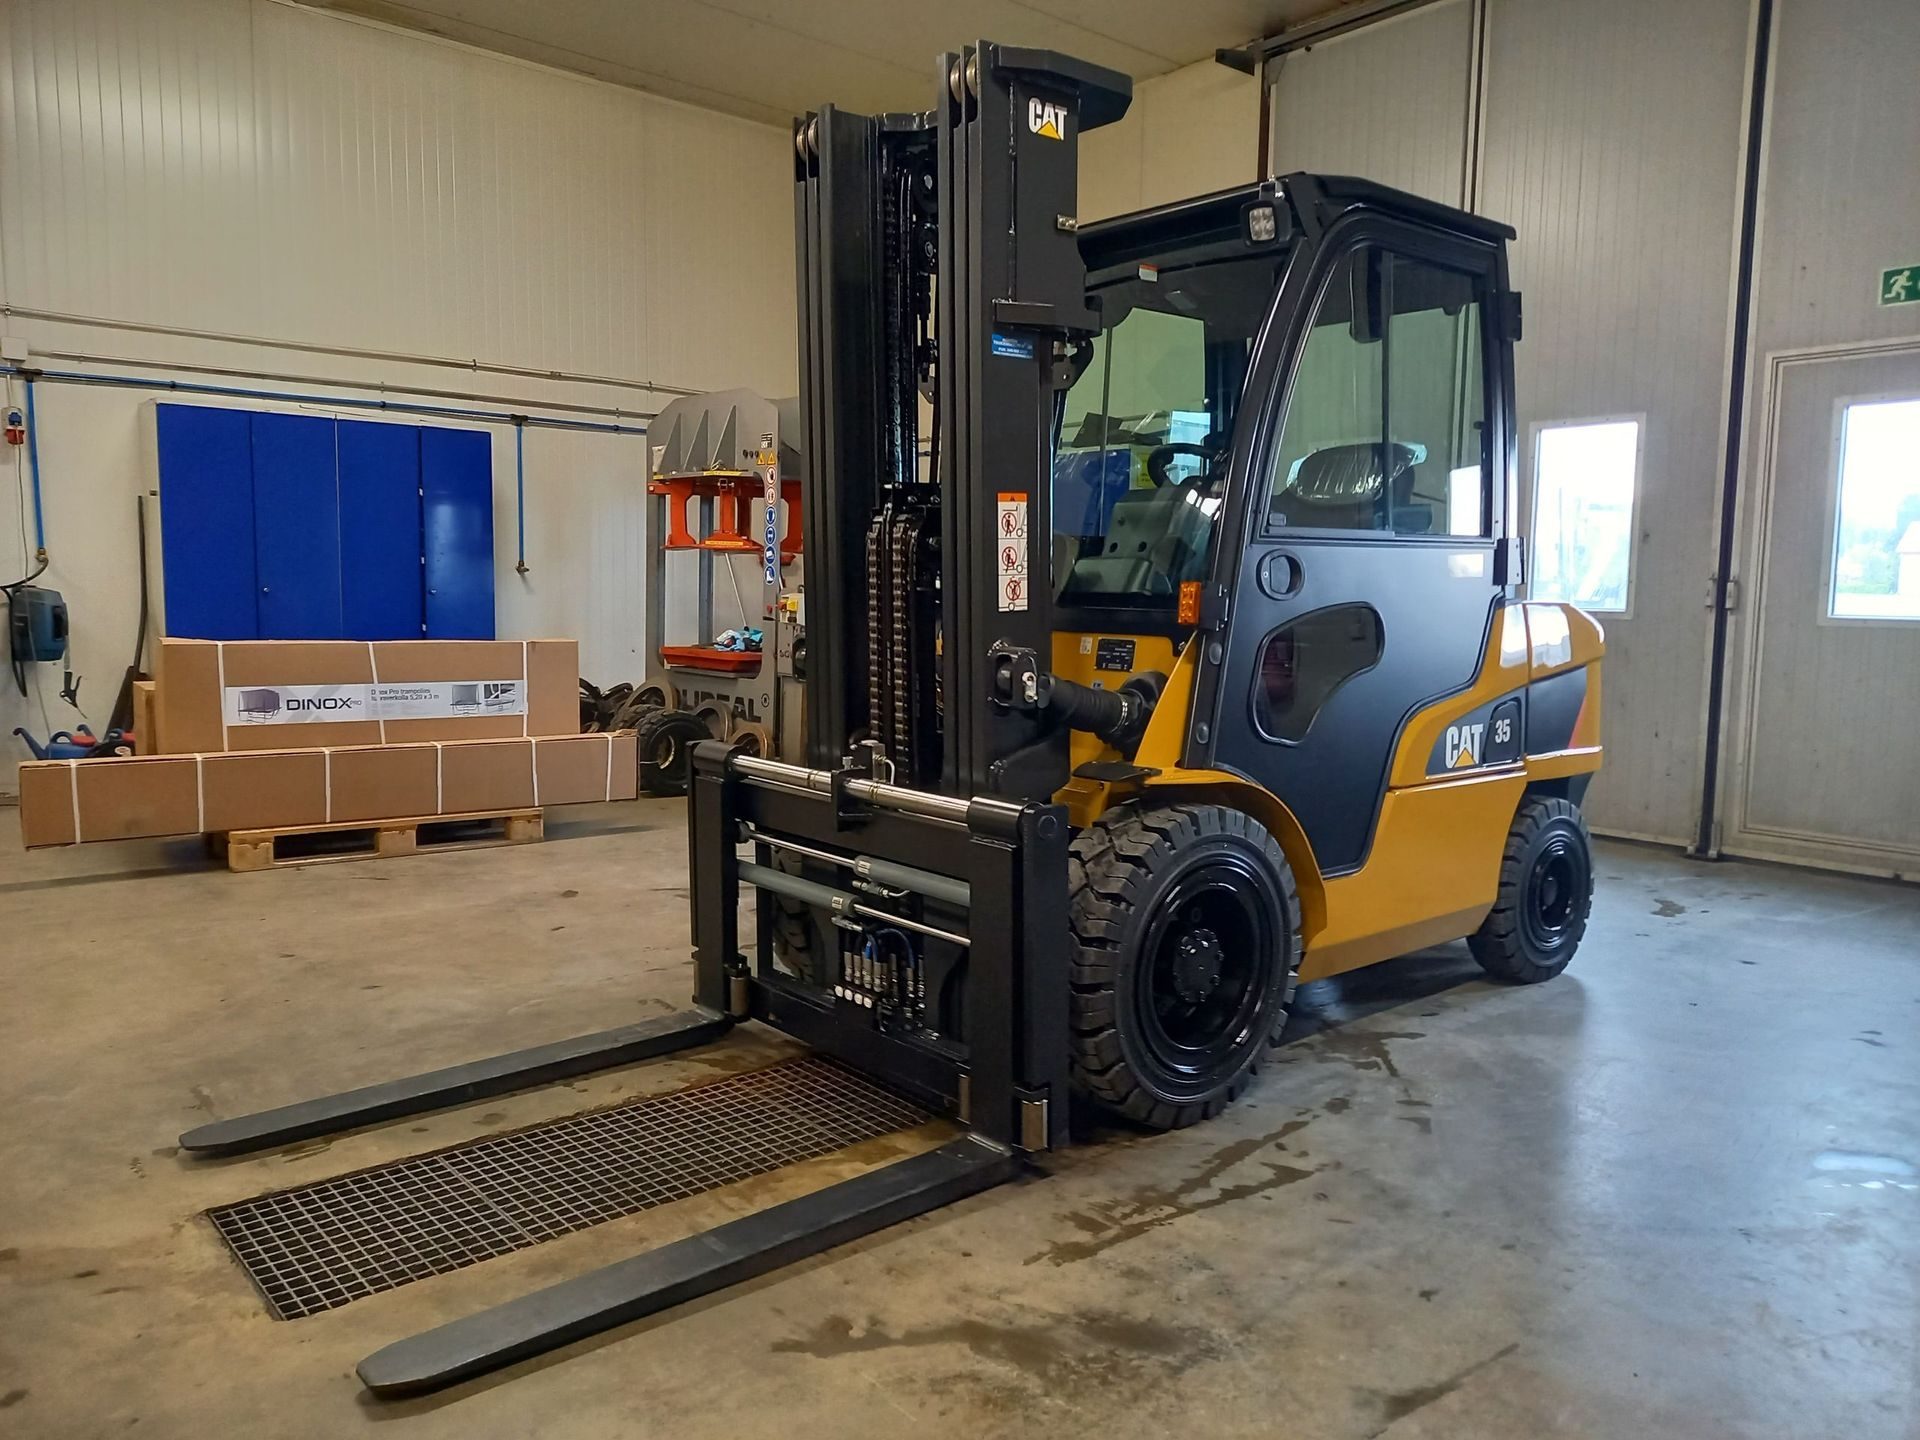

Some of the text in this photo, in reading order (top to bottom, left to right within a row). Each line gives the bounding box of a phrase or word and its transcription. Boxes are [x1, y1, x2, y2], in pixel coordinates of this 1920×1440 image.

[1029, 97, 1067, 140] CAT
[286, 697, 351, 711] DINOX
[1446, 723, 1483, 768] CAT
[1495, 718, 1510, 743] 35
